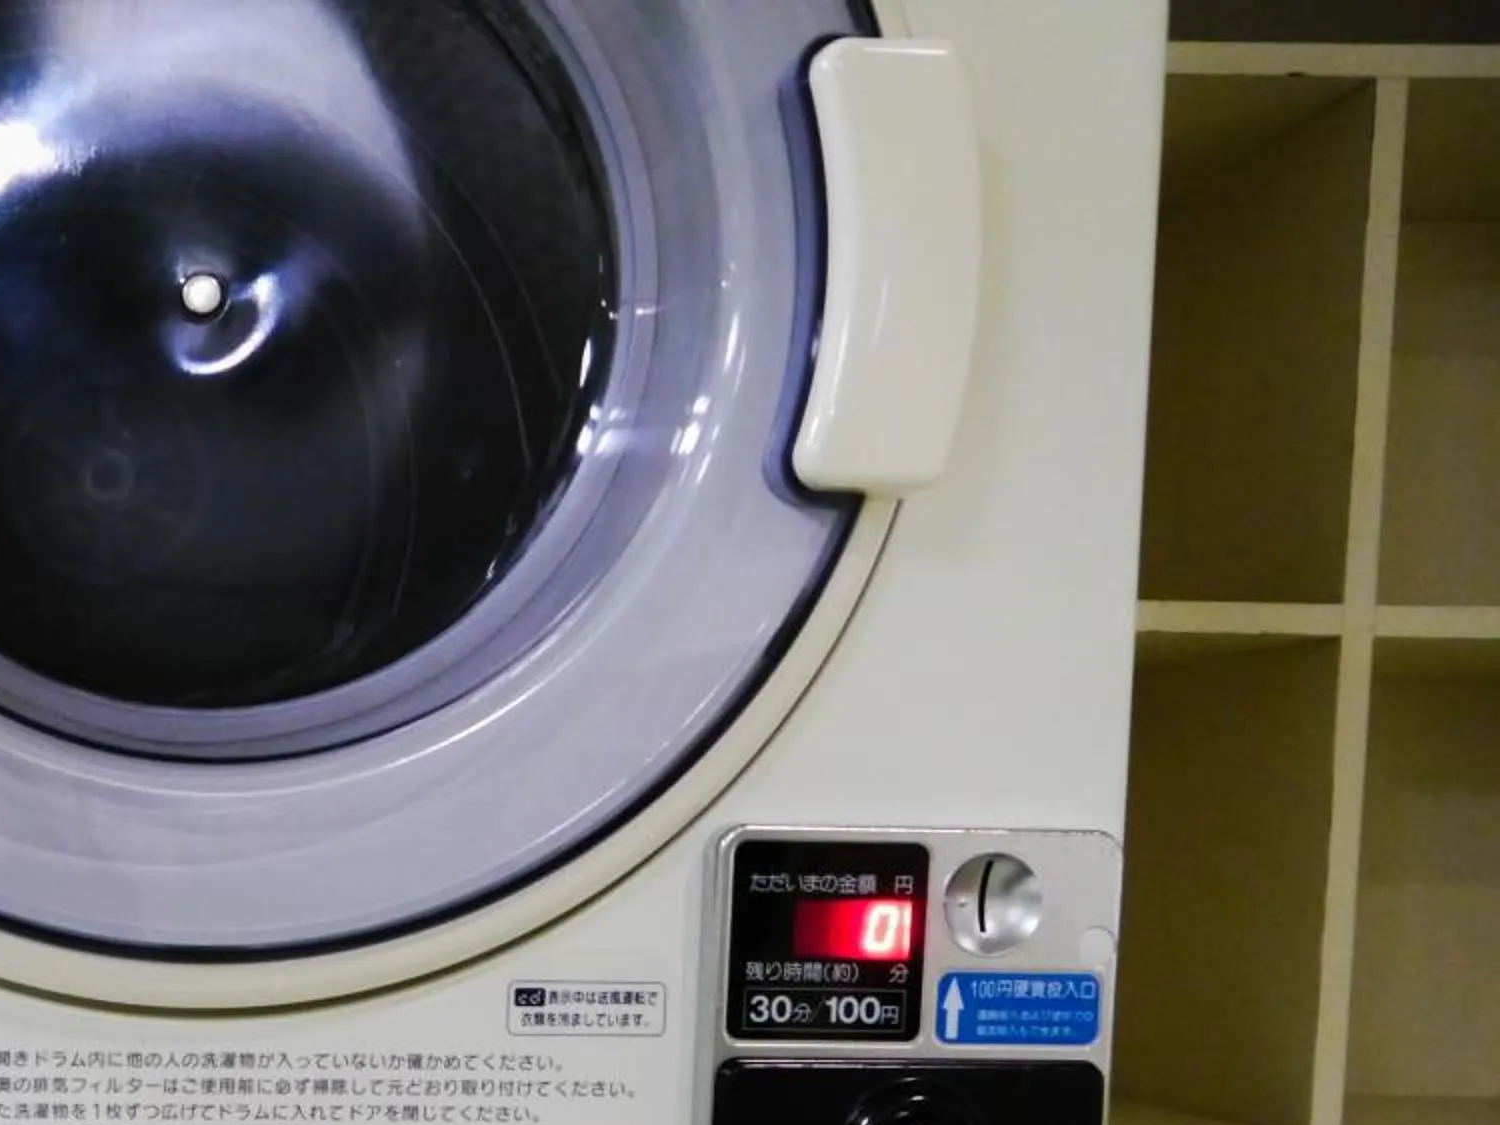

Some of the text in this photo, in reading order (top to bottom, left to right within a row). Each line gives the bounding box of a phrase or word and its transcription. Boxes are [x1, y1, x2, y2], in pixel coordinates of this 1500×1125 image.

[751, 875, 913, 894] ただいまの金額 円
[746, 961, 909, 984] 残り時間(約) 分
[970, 979, 1097, 1000] 100円硬貨投入口
